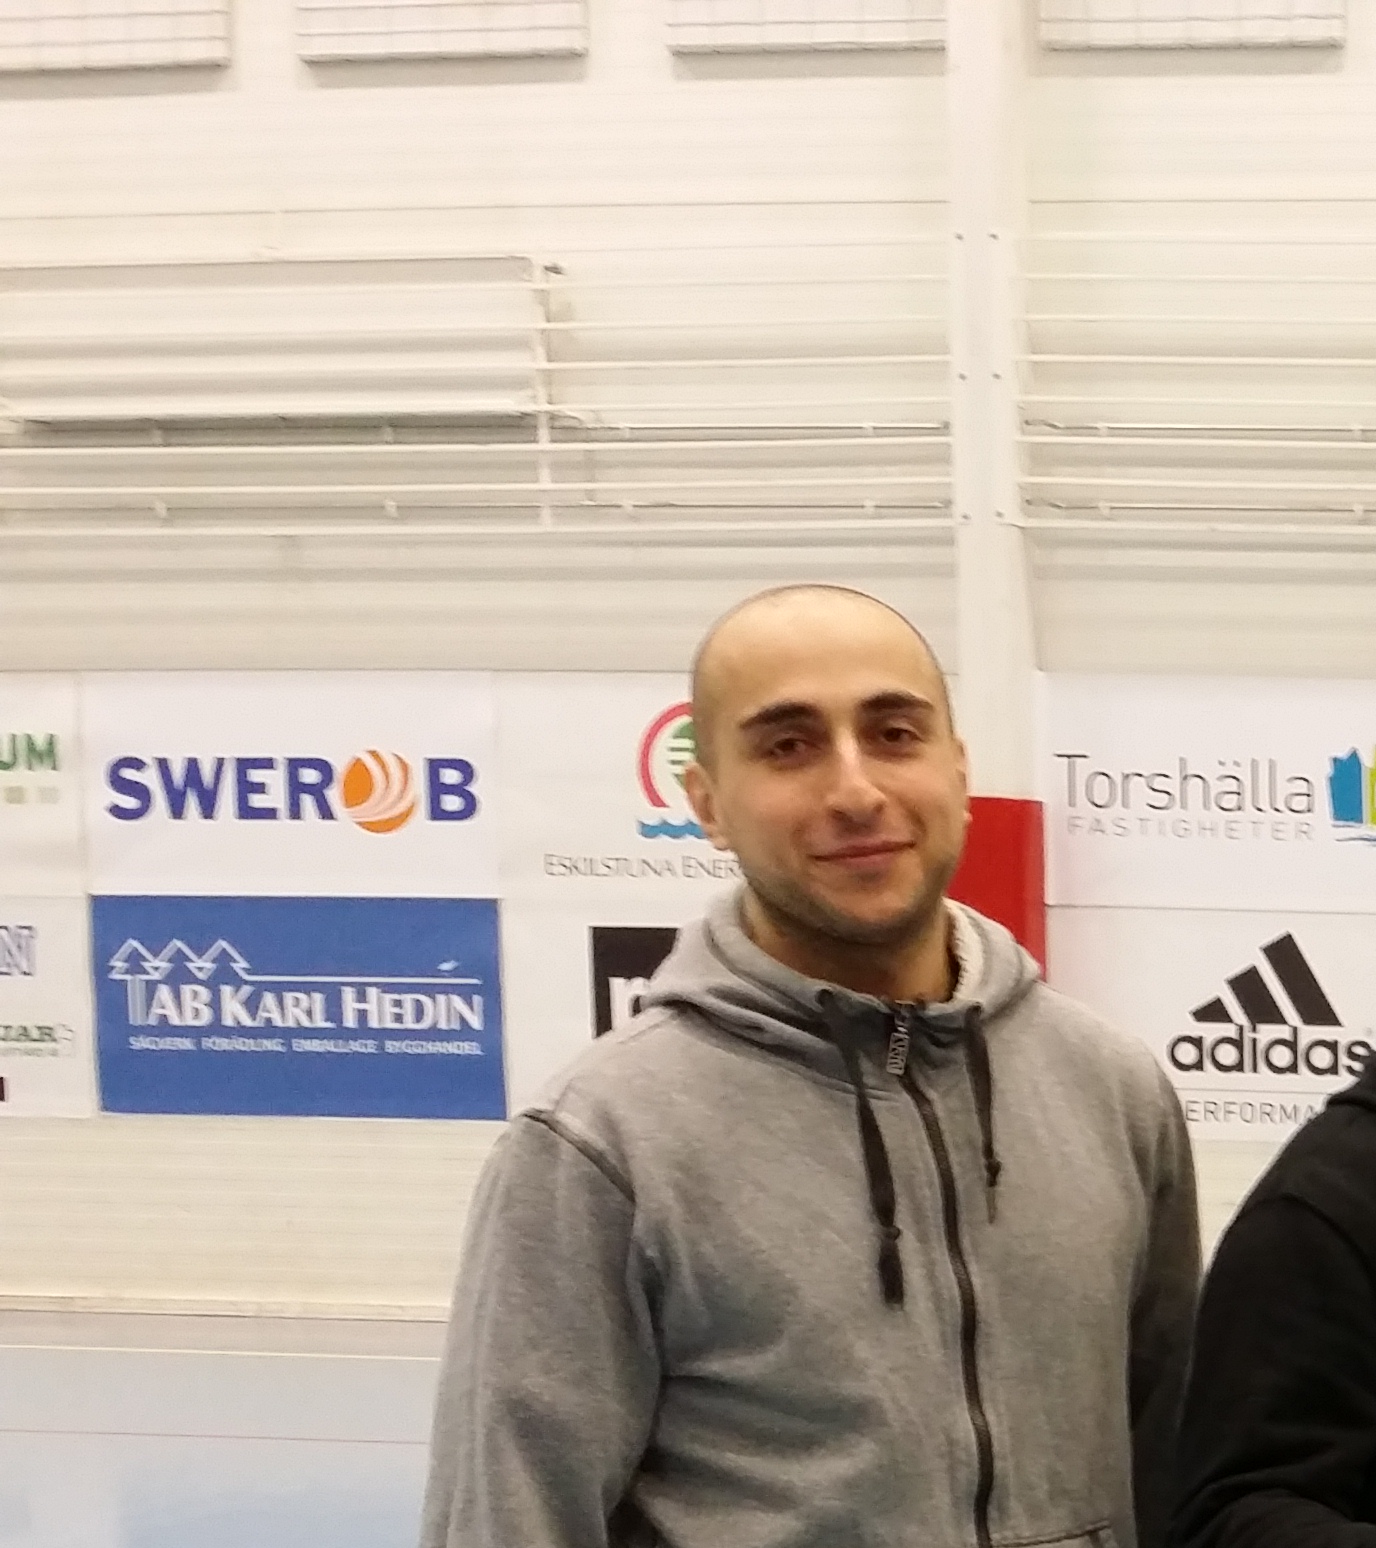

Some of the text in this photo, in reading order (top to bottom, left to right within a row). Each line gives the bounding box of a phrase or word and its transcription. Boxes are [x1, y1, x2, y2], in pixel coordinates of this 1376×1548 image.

[1053, 752, 1315, 813] Torshälla
[1067, 817, 1315, 841] FASTIGHETER
[543, 853, 674, 878] ESKILSTUNA
[1165, 1023, 1373, 1078] adidas
